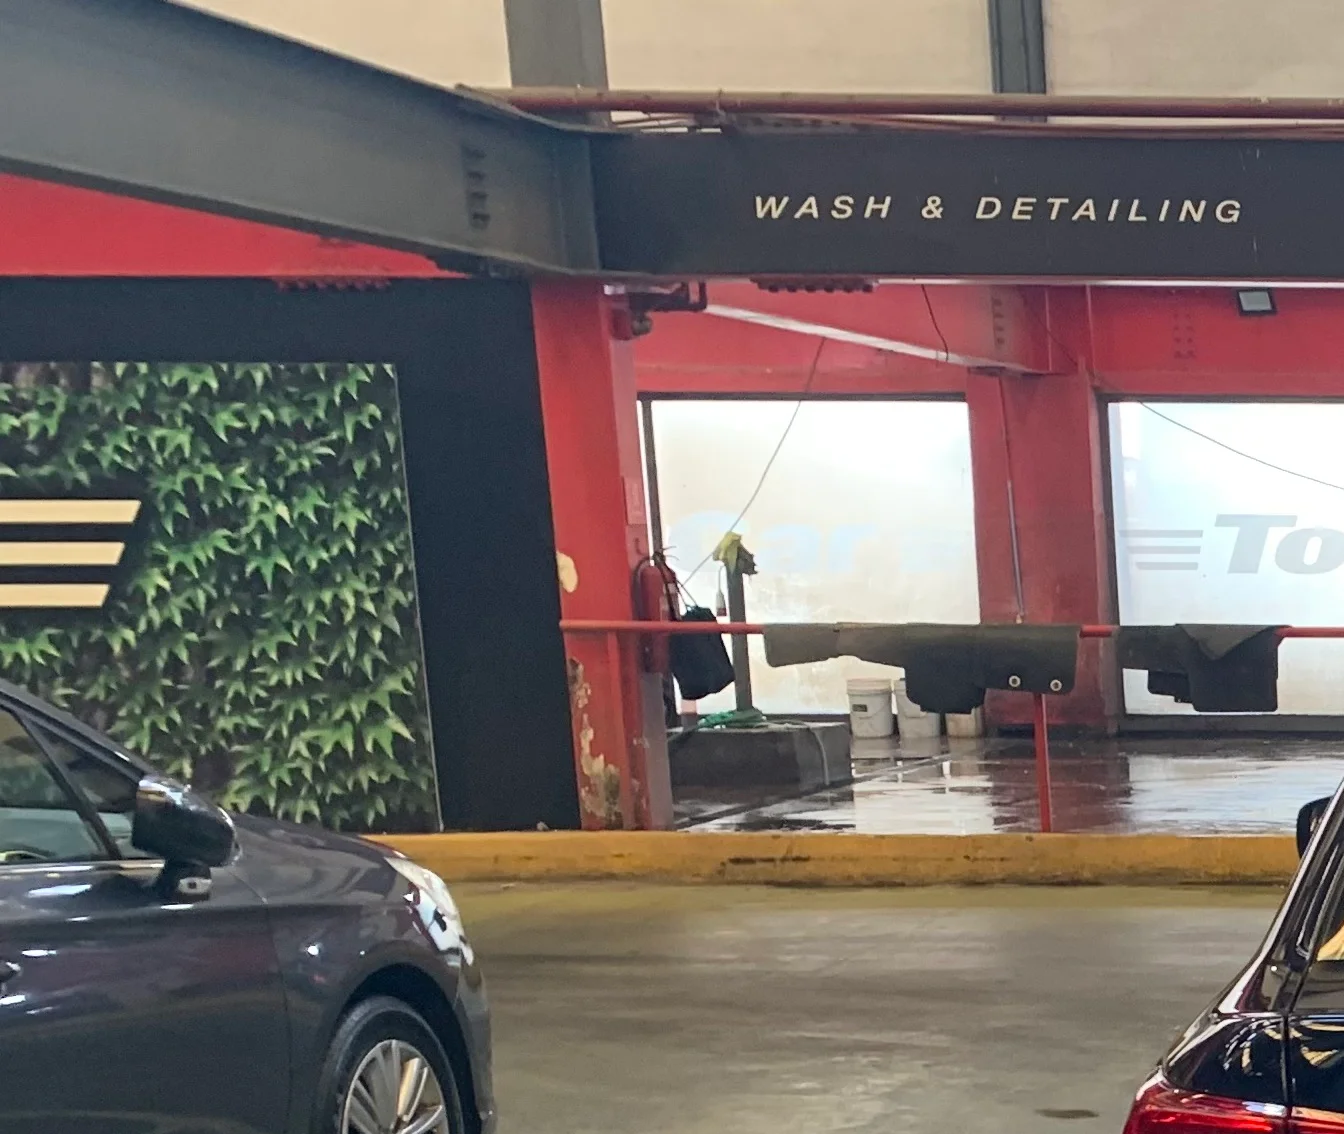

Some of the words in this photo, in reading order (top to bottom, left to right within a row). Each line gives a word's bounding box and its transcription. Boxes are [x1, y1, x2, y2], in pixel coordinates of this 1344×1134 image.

[755, 195, 891, 219] WASH
[921, 195, 944, 219] &
[975, 196, 1243, 223] DETAILING
